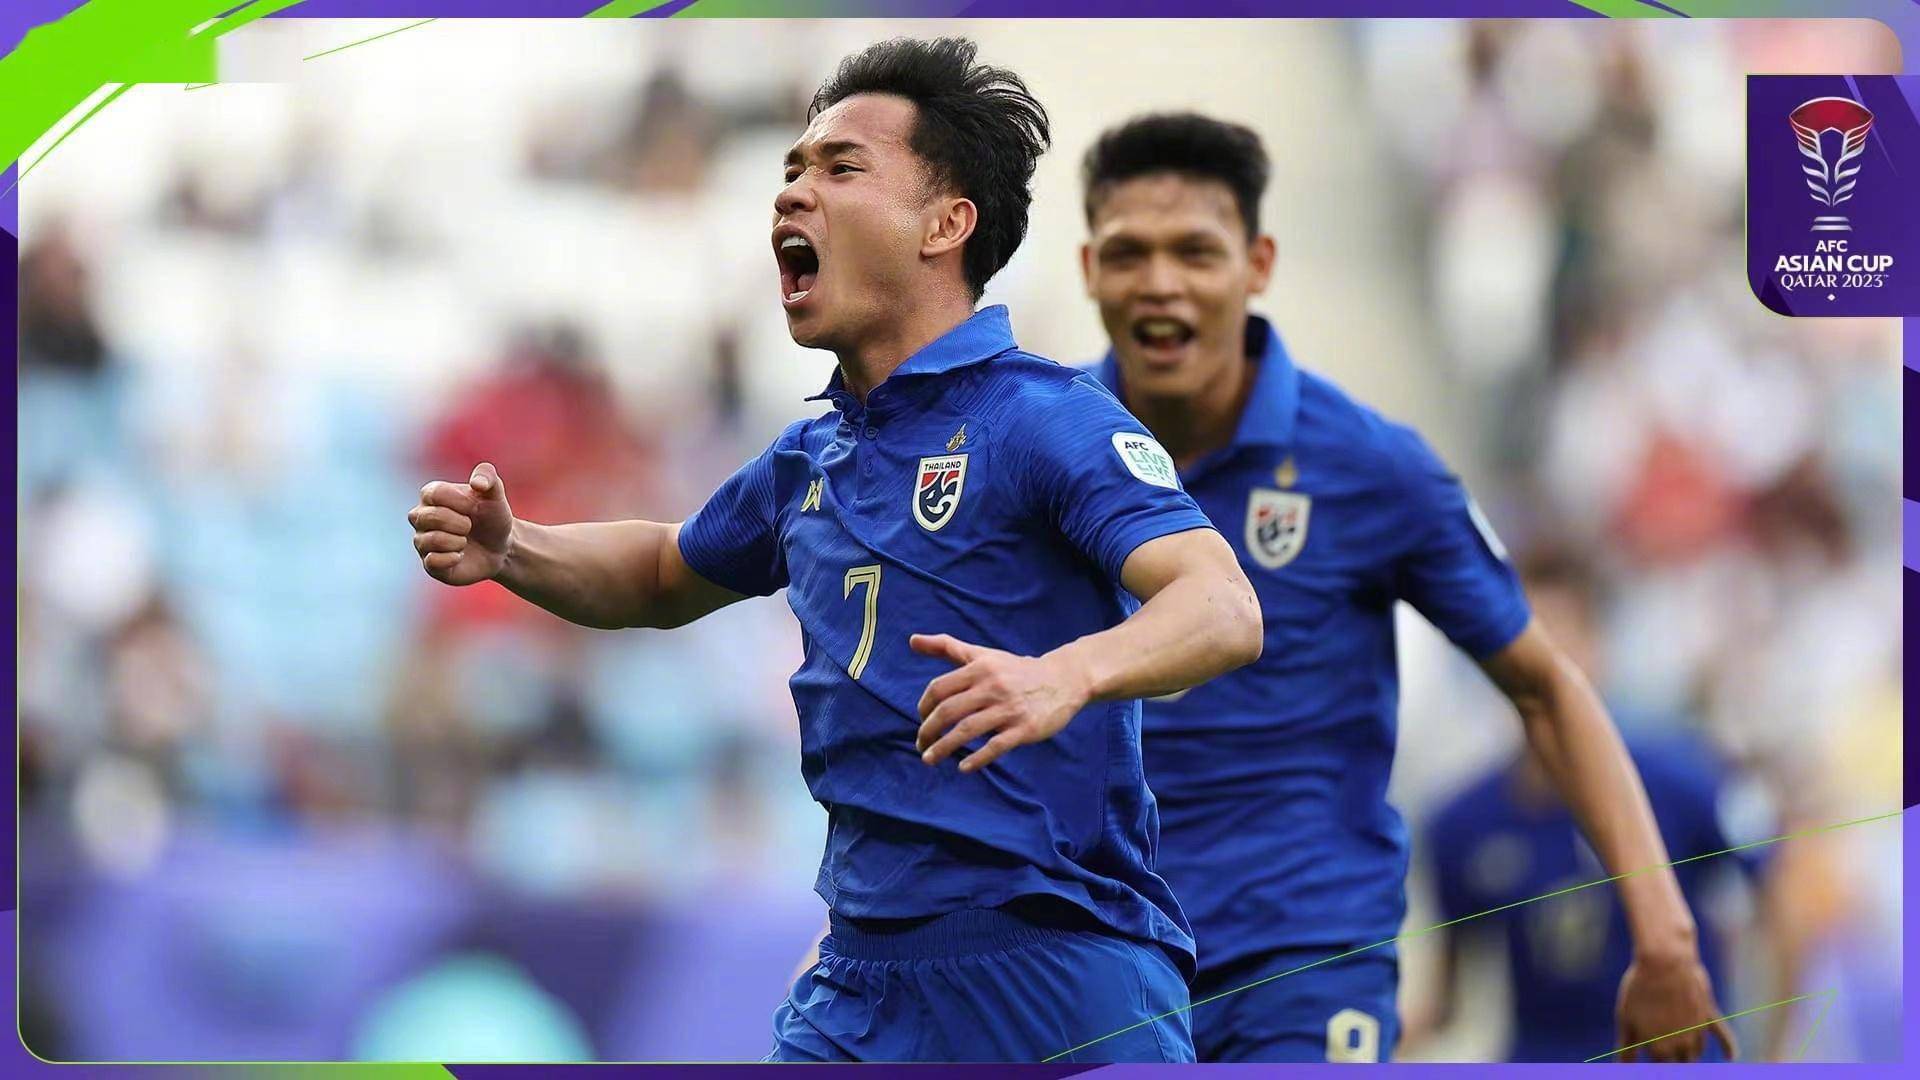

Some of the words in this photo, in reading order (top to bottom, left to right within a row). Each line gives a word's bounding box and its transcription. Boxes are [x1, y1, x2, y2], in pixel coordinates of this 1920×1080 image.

[1124, 441, 1149, 451] AFC
[924, 460, 962, 471] THAILAND
[844, 564, 881, 680] 7
